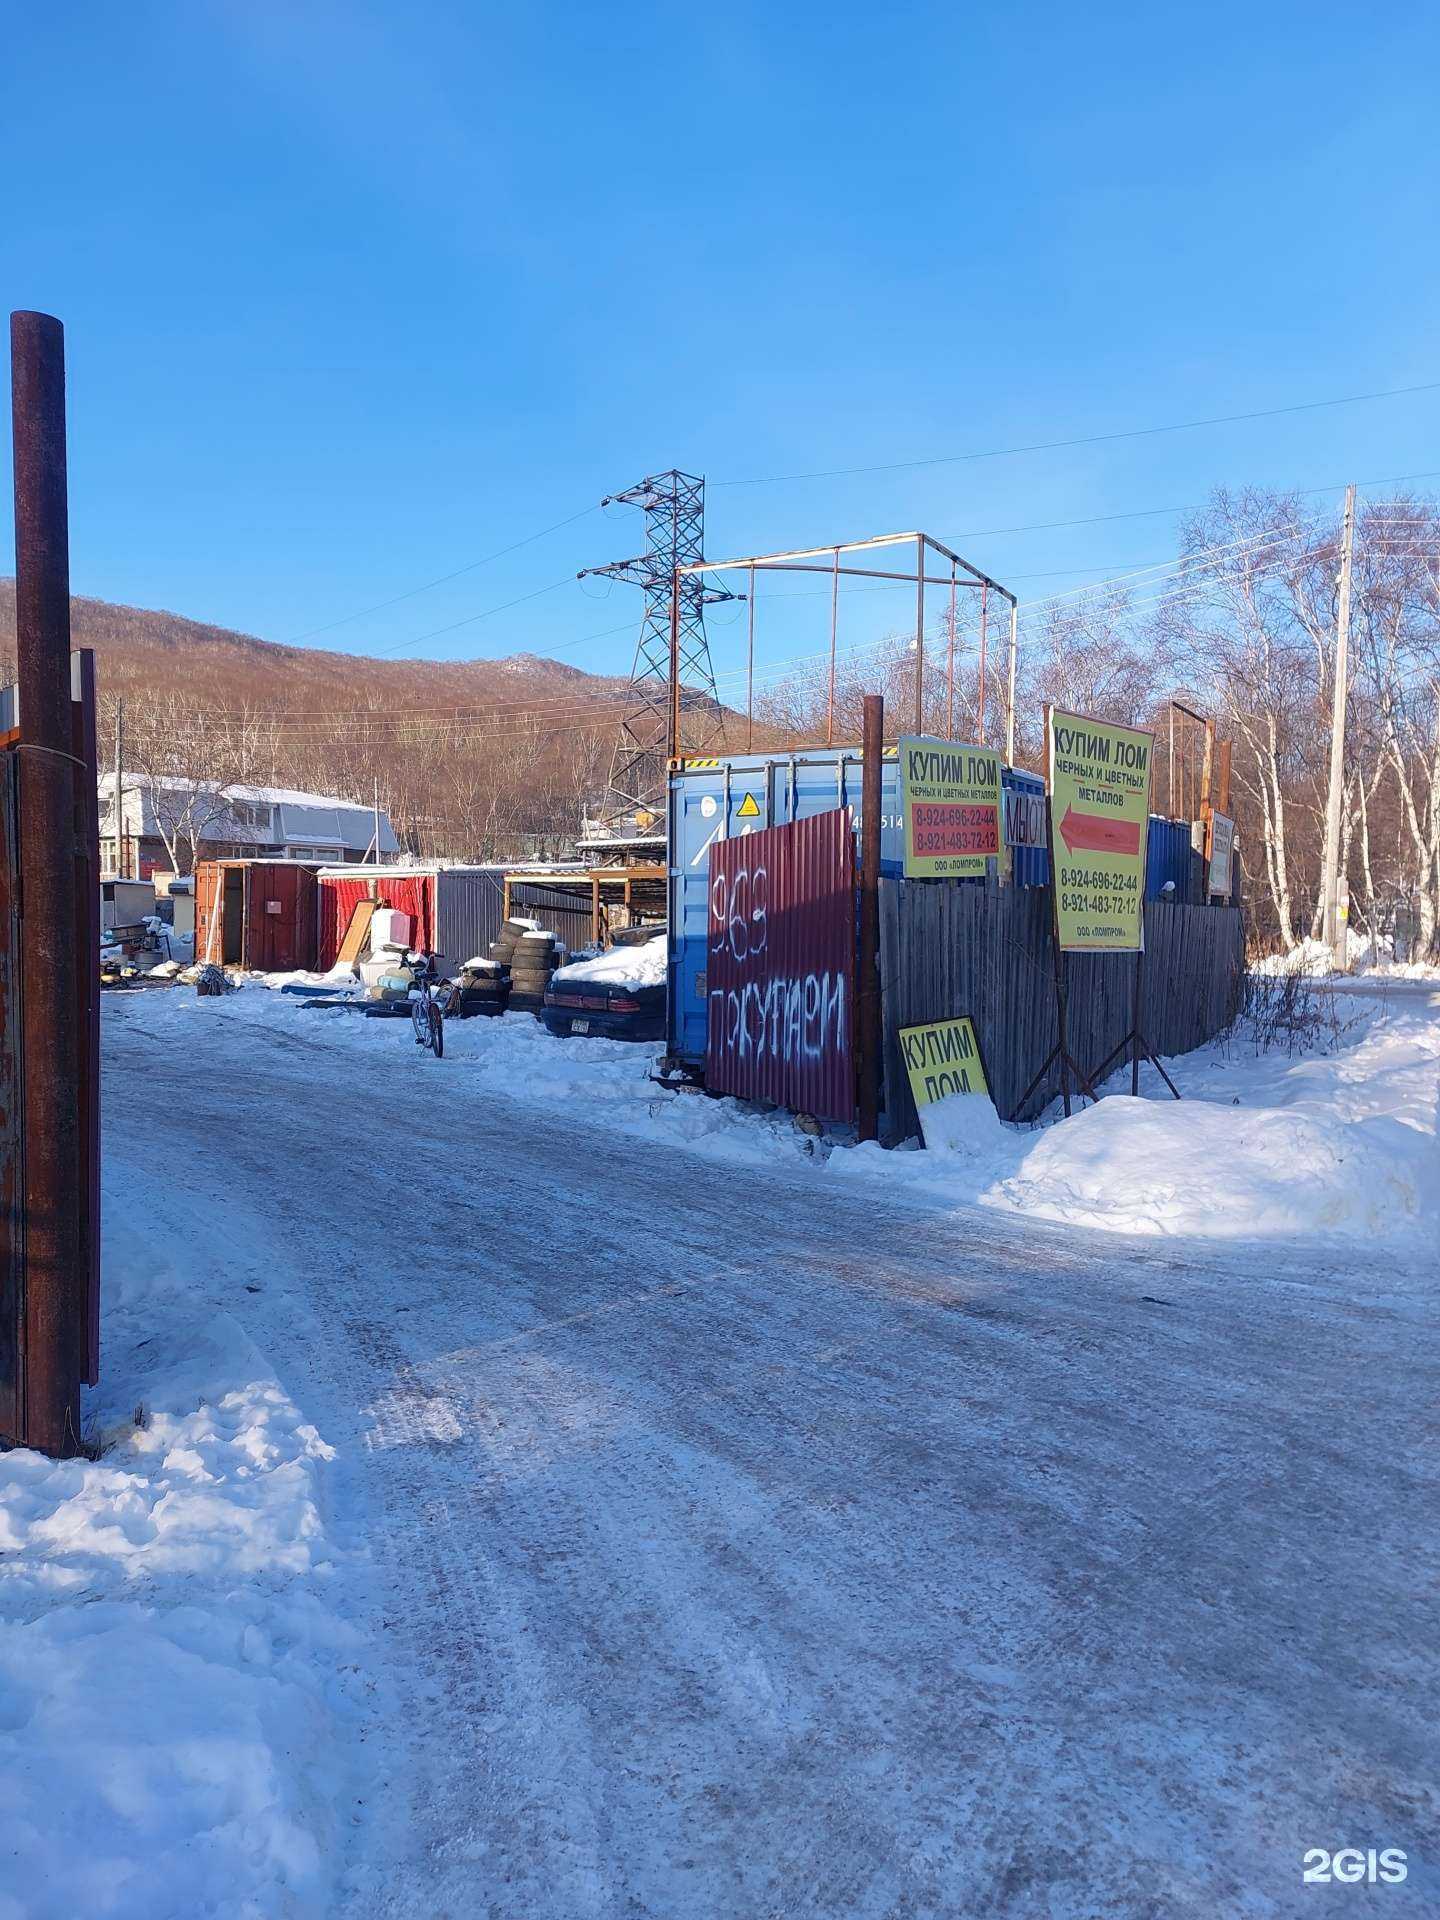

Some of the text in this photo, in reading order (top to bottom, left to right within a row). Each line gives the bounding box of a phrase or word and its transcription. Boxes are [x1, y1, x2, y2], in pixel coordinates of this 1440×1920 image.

[1055, 726, 1148, 771] КУПИМ ЛОМ
[909, 751, 997, 786] КУПИМ ЛОМ
[1056, 759, 1144, 788] ЧЕРНЫХ И ЦВЕТНЫХ
[911, 787, 997, 800] ЧЕРНЫХ И ЦВЕТНЫХ МЕТАЛЛОВ
[1079, 787, 1124, 807] МЕТАЛЛОВ
[917, 808, 994, 827] 8-924-696-22-44
[917, 831, 996, 850] 8-921-483-72-12
[935, 860, 947, 871] ООО
[1061, 868, 1137, 892] 8-924-696-22-44
[1061, 893, 1136, 914] 8-921-483-72-12
[1077, 926, 1090, 937] ООО
[902, 1025, 974, 1071] КУПИМ
